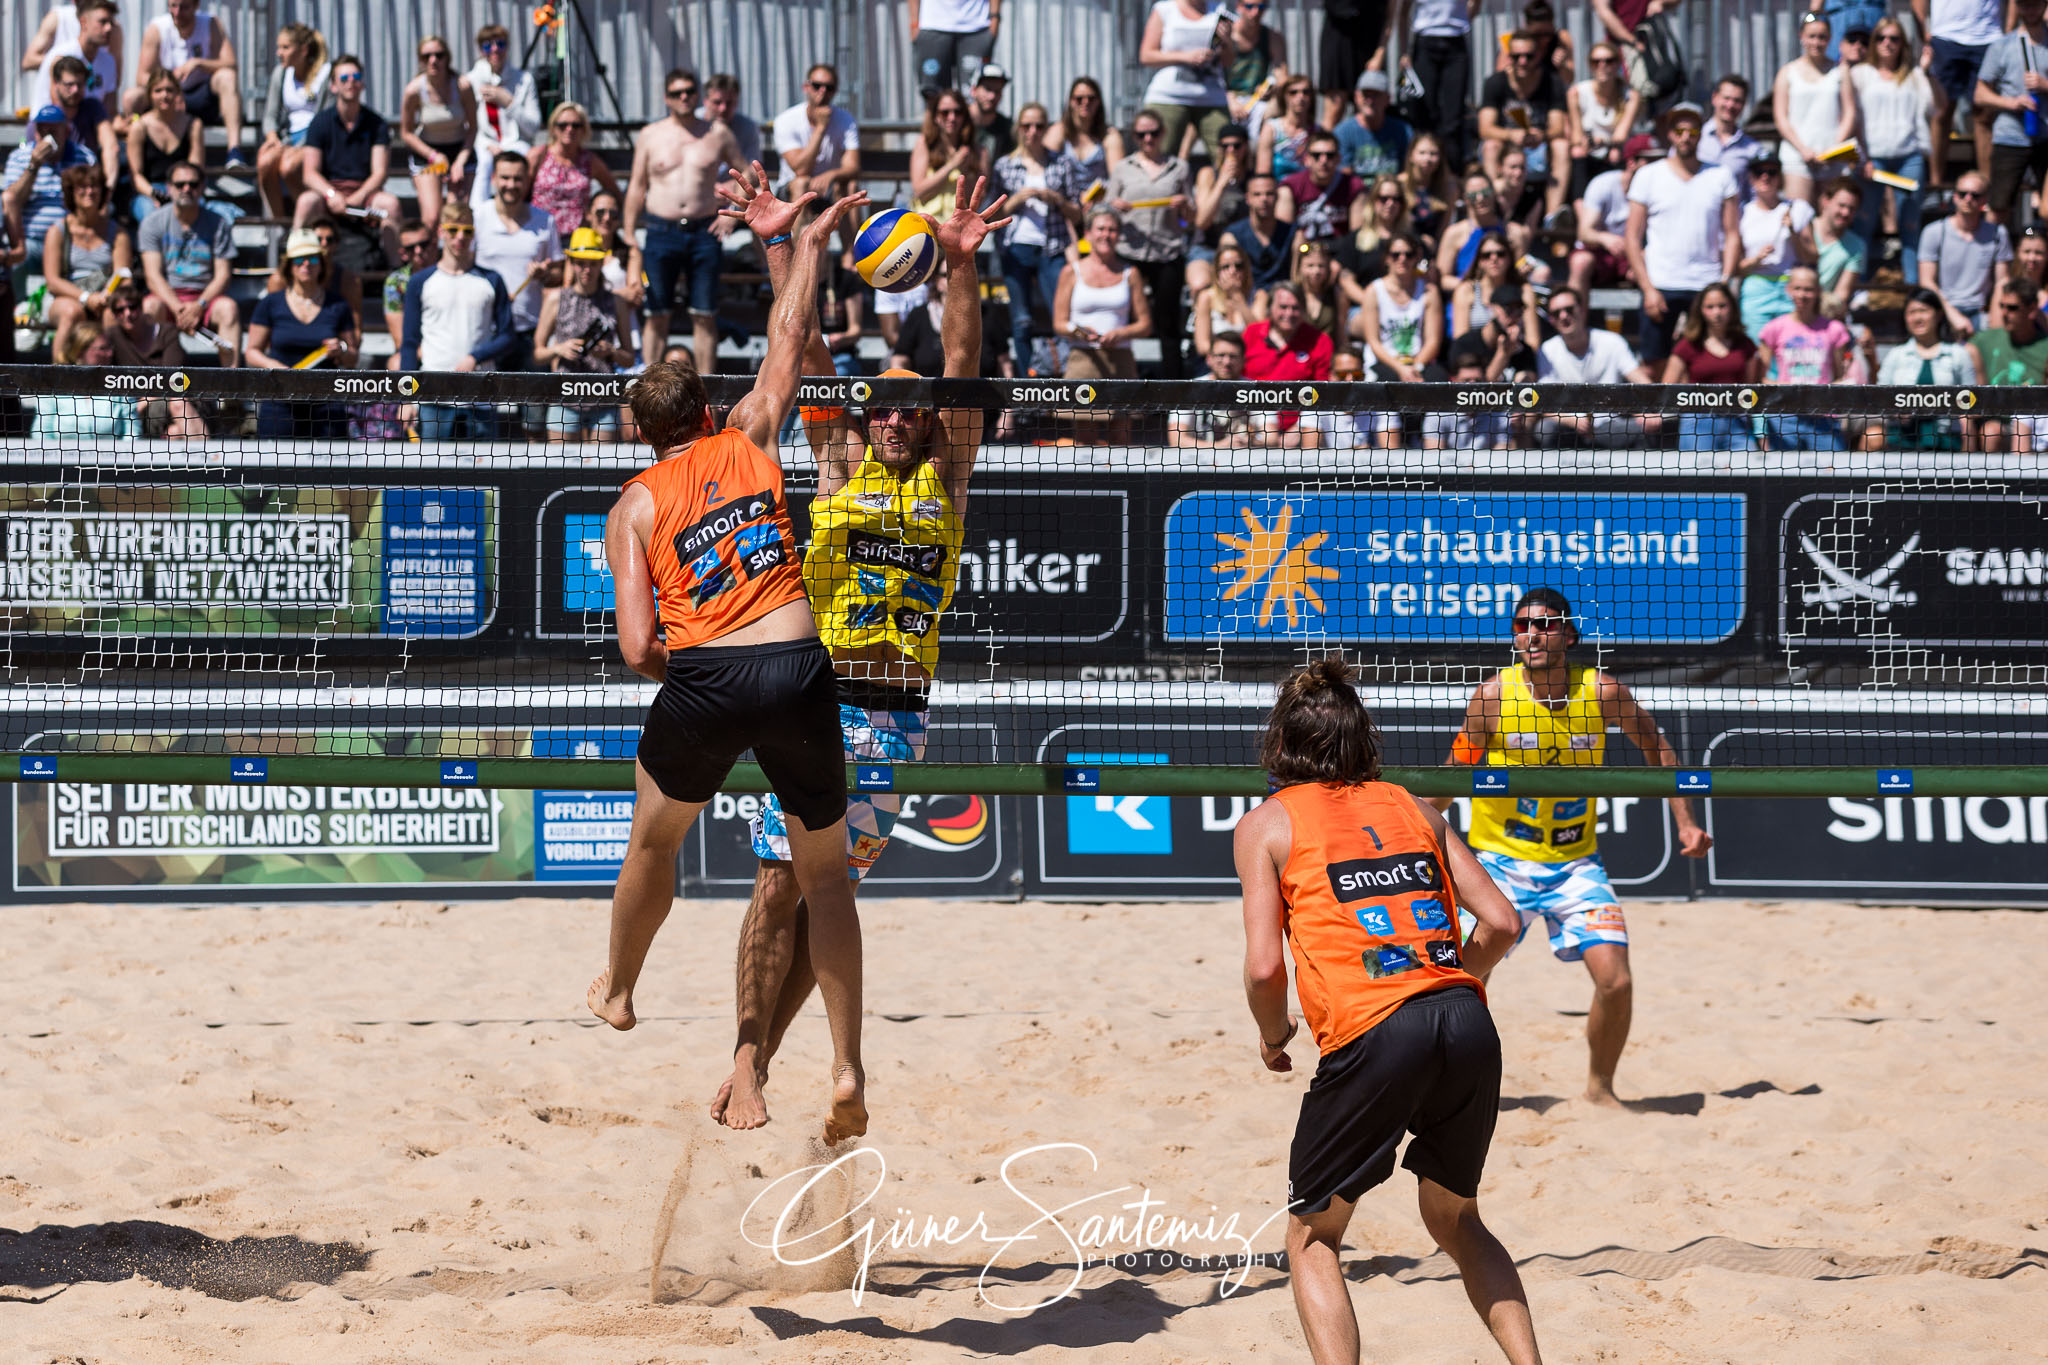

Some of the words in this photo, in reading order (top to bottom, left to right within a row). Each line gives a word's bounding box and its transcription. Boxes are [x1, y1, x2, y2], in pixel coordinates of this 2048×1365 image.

[104, 373, 164, 391] smart
[333, 376, 393, 394] smart
[561, 380, 620, 397] smart
[798, 383, 846, 399] mart
[1011, 386, 1070, 403] smart
[1235, 387, 1293, 404] smart
[1456, 390, 1513, 407] smart
[1676, 390, 1733, 407] smart
[1894, 391, 1951, 408] smart
[703, 481, 725, 505] 2
[7, 520, 75, 560] DER
[85, 520, 344, 562] VIRENBLOCKER
[684, 508, 746, 552] smart
[1367, 517, 1700, 565] schauinsland
[750, 548, 780, 571] sky
[954, 538, 1102, 593] niker
[1946, 548, 2048, 586] SAN
[154, 562, 341, 600] NETZWERK!
[1367, 571, 1523, 617] reisen
[57, 783, 112, 814] SEI
[124, 784, 194, 813] DER
[544, 801, 633, 820] OFFIZIELLER
[57, 811, 110, 847] FÜR
[117, 813, 322, 846] DEUTSCHLANDS
[328, 812, 491, 844] SICHERHEIT!
[1361, 825, 1383, 851] 1
[1338, 863, 1413, 891] smart
[1363, 911, 1387, 926] TK
